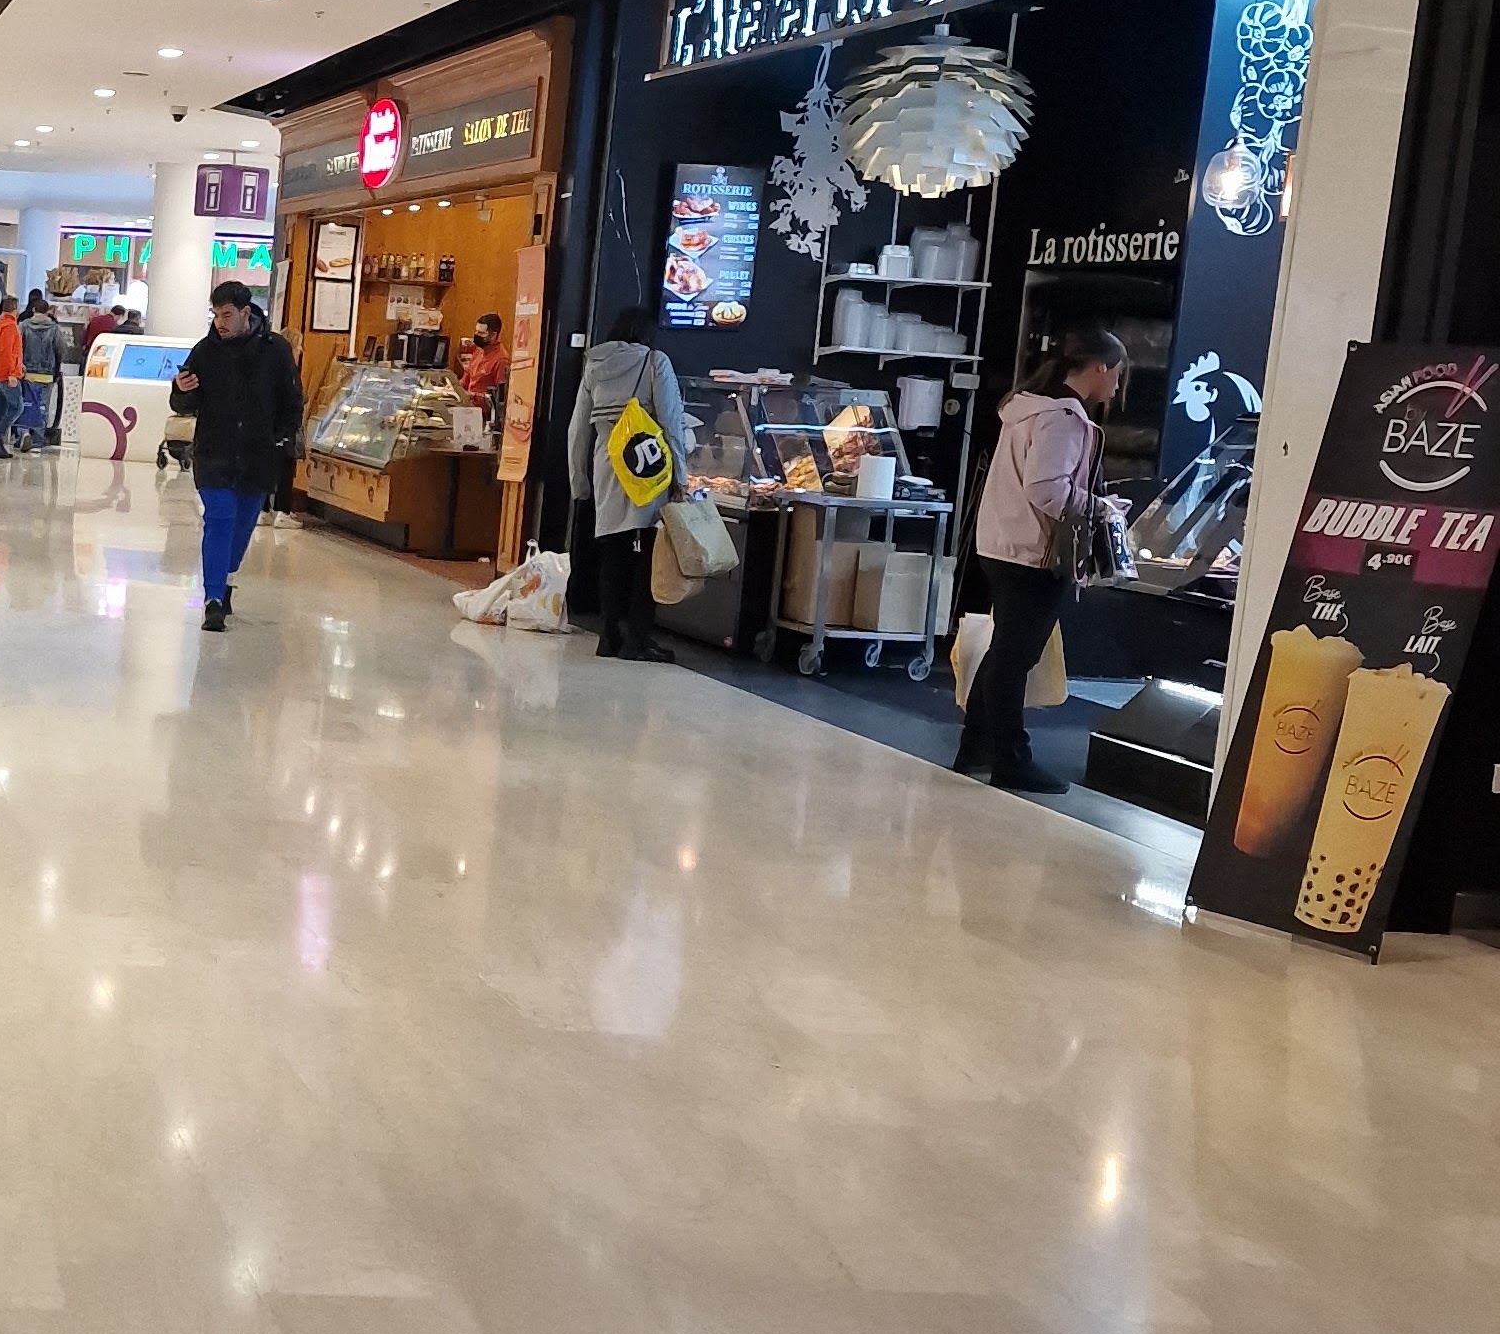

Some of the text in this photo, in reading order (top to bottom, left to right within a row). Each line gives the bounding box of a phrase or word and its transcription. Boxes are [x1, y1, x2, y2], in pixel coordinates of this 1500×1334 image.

[494, 112, 510, 139] DE
[681, 183, 753, 197] ROTISSERIE
[1027, 218, 1180, 265] La rotisserie
[1372, 362, 1458, 415] ASIAN FOOD
[634, 438, 662, 474] JD
[1382, 418, 1482, 459] BAZE
[1302, 497, 1495, 553] BUBBLE TEA
[1402, 634, 1442, 654] LAIT
[1344, 775, 1398, 805] BAZE
